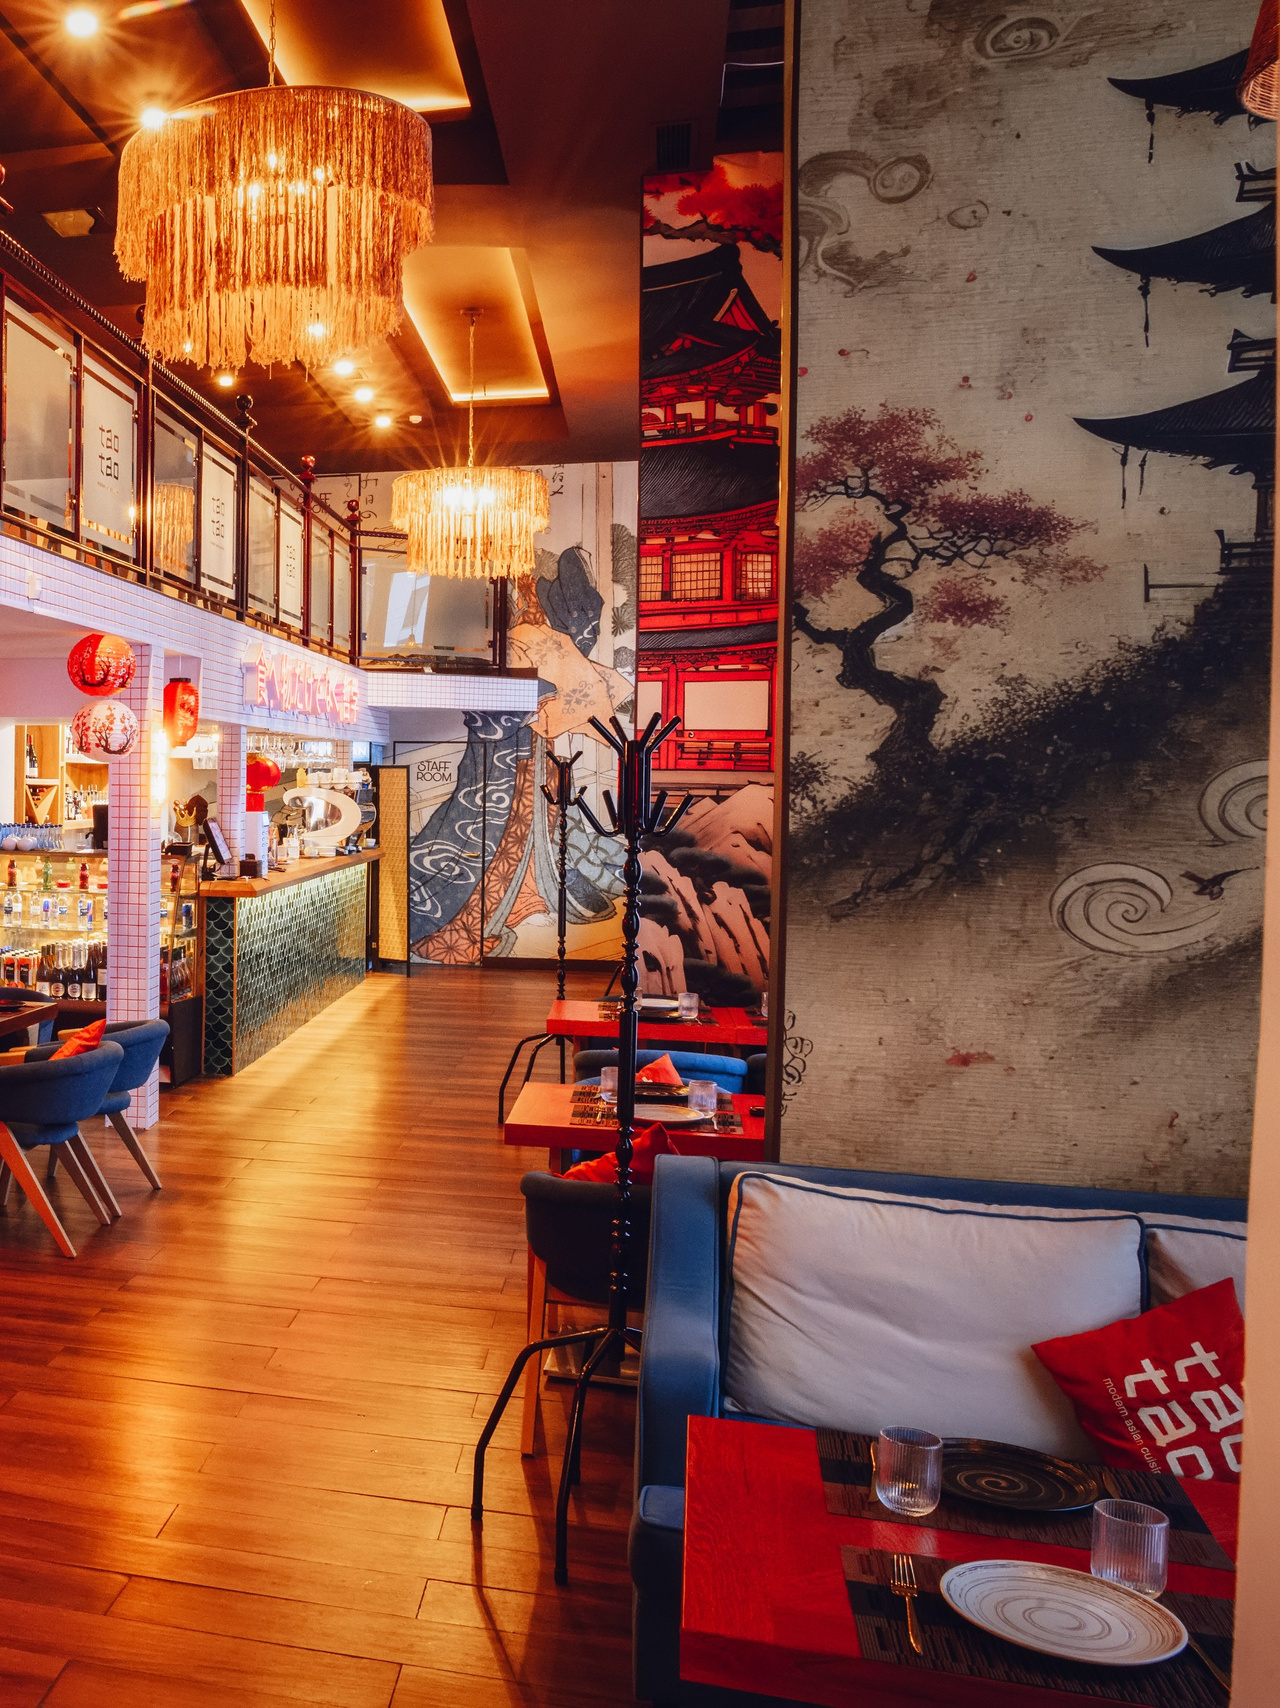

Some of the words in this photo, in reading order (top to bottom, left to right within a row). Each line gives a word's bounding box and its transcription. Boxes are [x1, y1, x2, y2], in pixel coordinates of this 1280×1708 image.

[99, 425, 119, 453] tao
[99, 453, 119, 480] tao
[416, 772, 452, 782] ROOM
[417, 760, 452, 771] STAFF
[1103, 1378, 1129, 1418] modern
[1124, 1419, 1144, 1446] asian
[1124, 1358, 1214, 1481] tao
